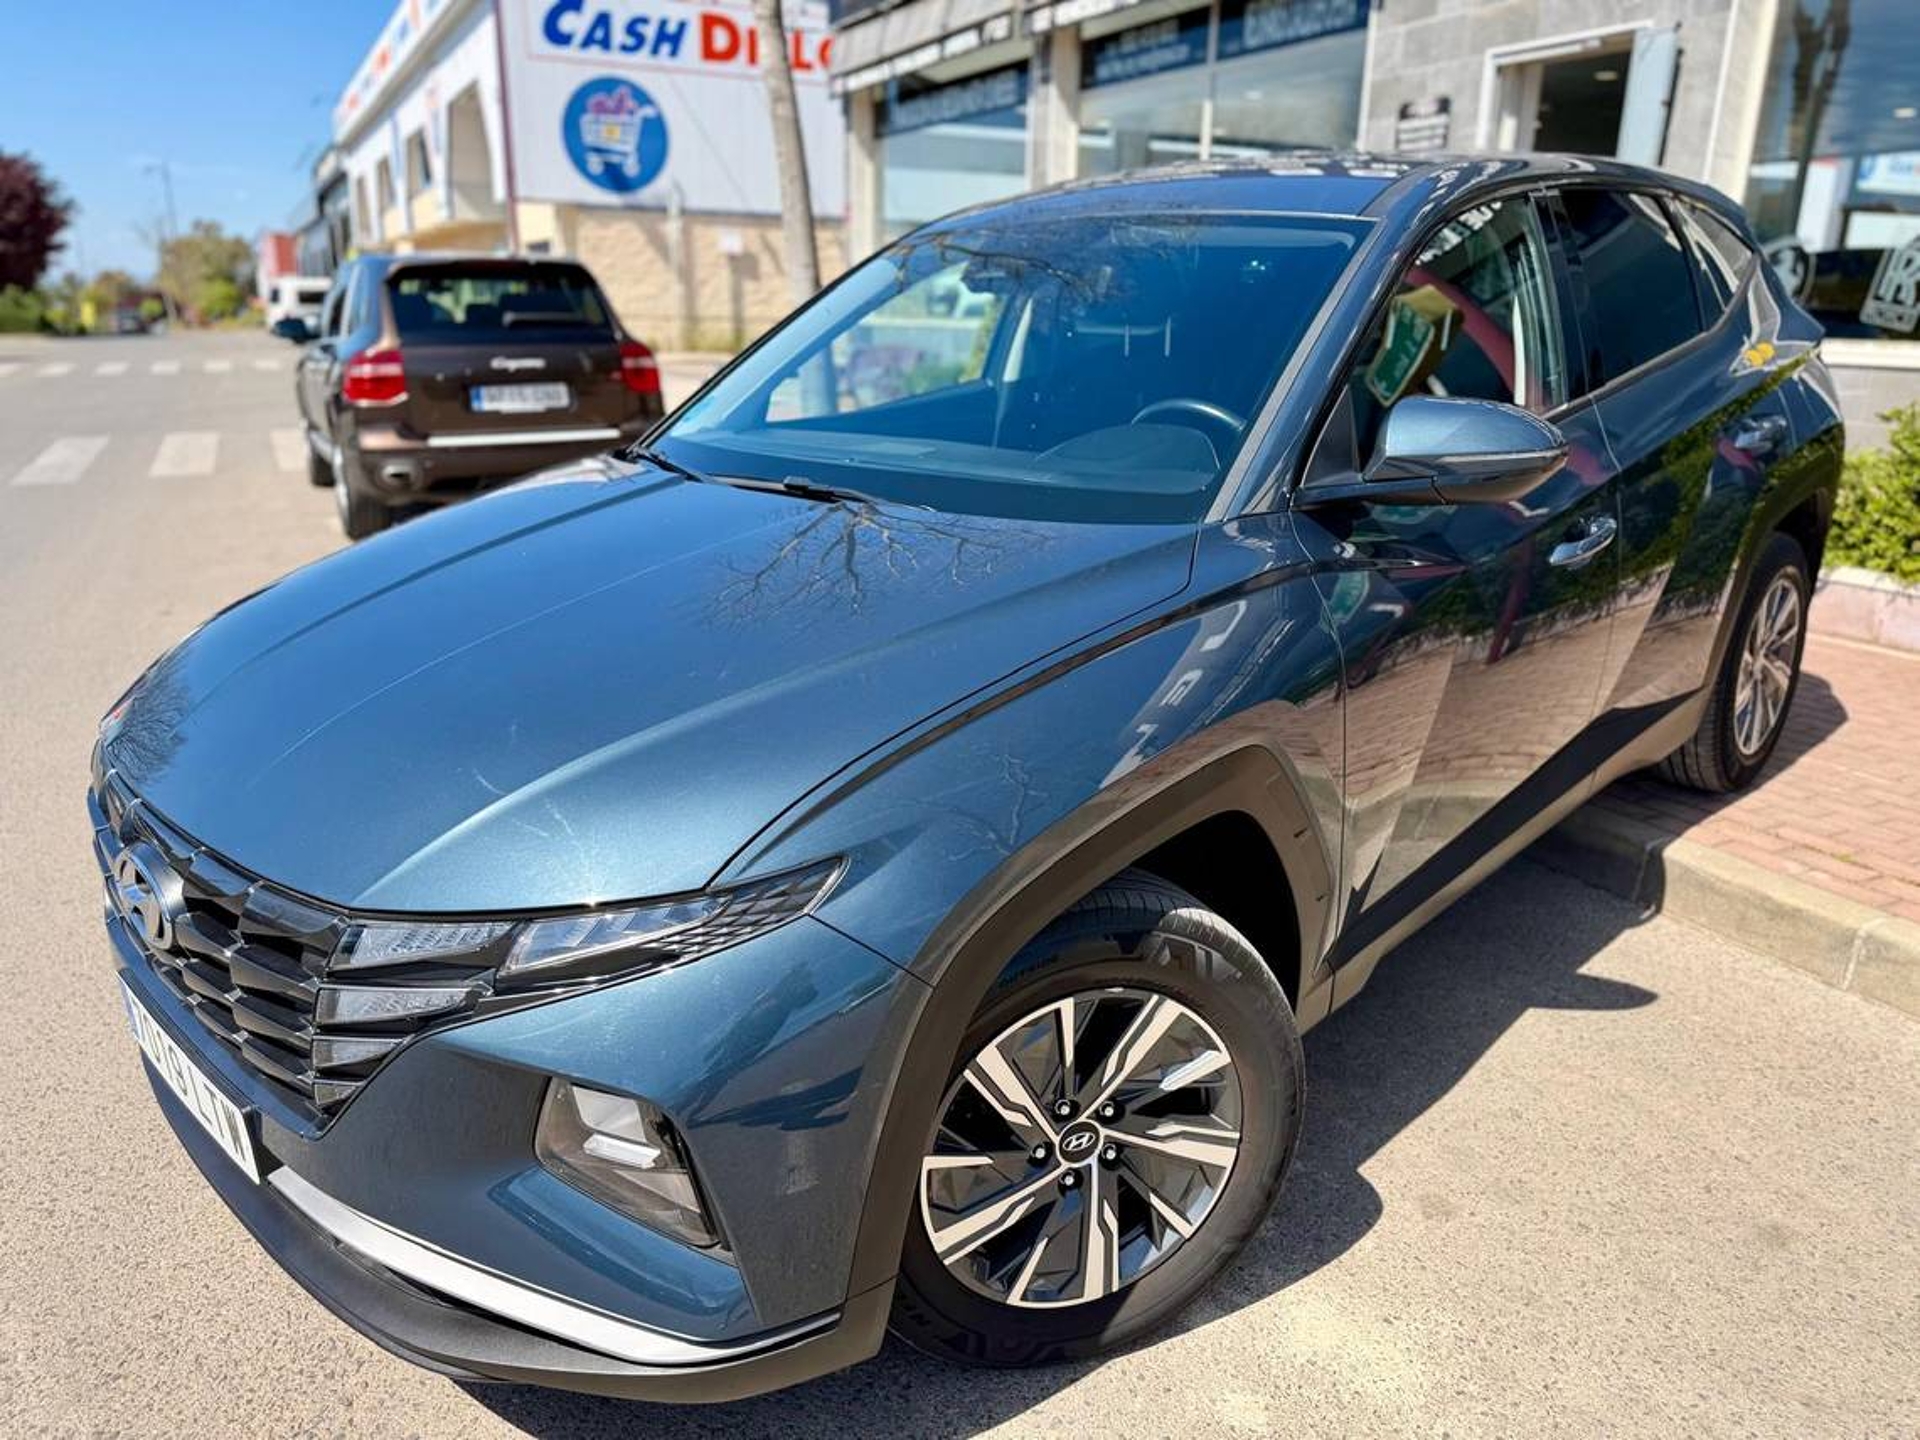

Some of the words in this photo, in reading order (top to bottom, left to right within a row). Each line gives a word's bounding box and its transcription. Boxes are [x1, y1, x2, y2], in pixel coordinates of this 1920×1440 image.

[542, 0, 688, 58] CASH
[132, 1000, 188, 1097] 7019
[187, 1065, 248, 1163] LTW
